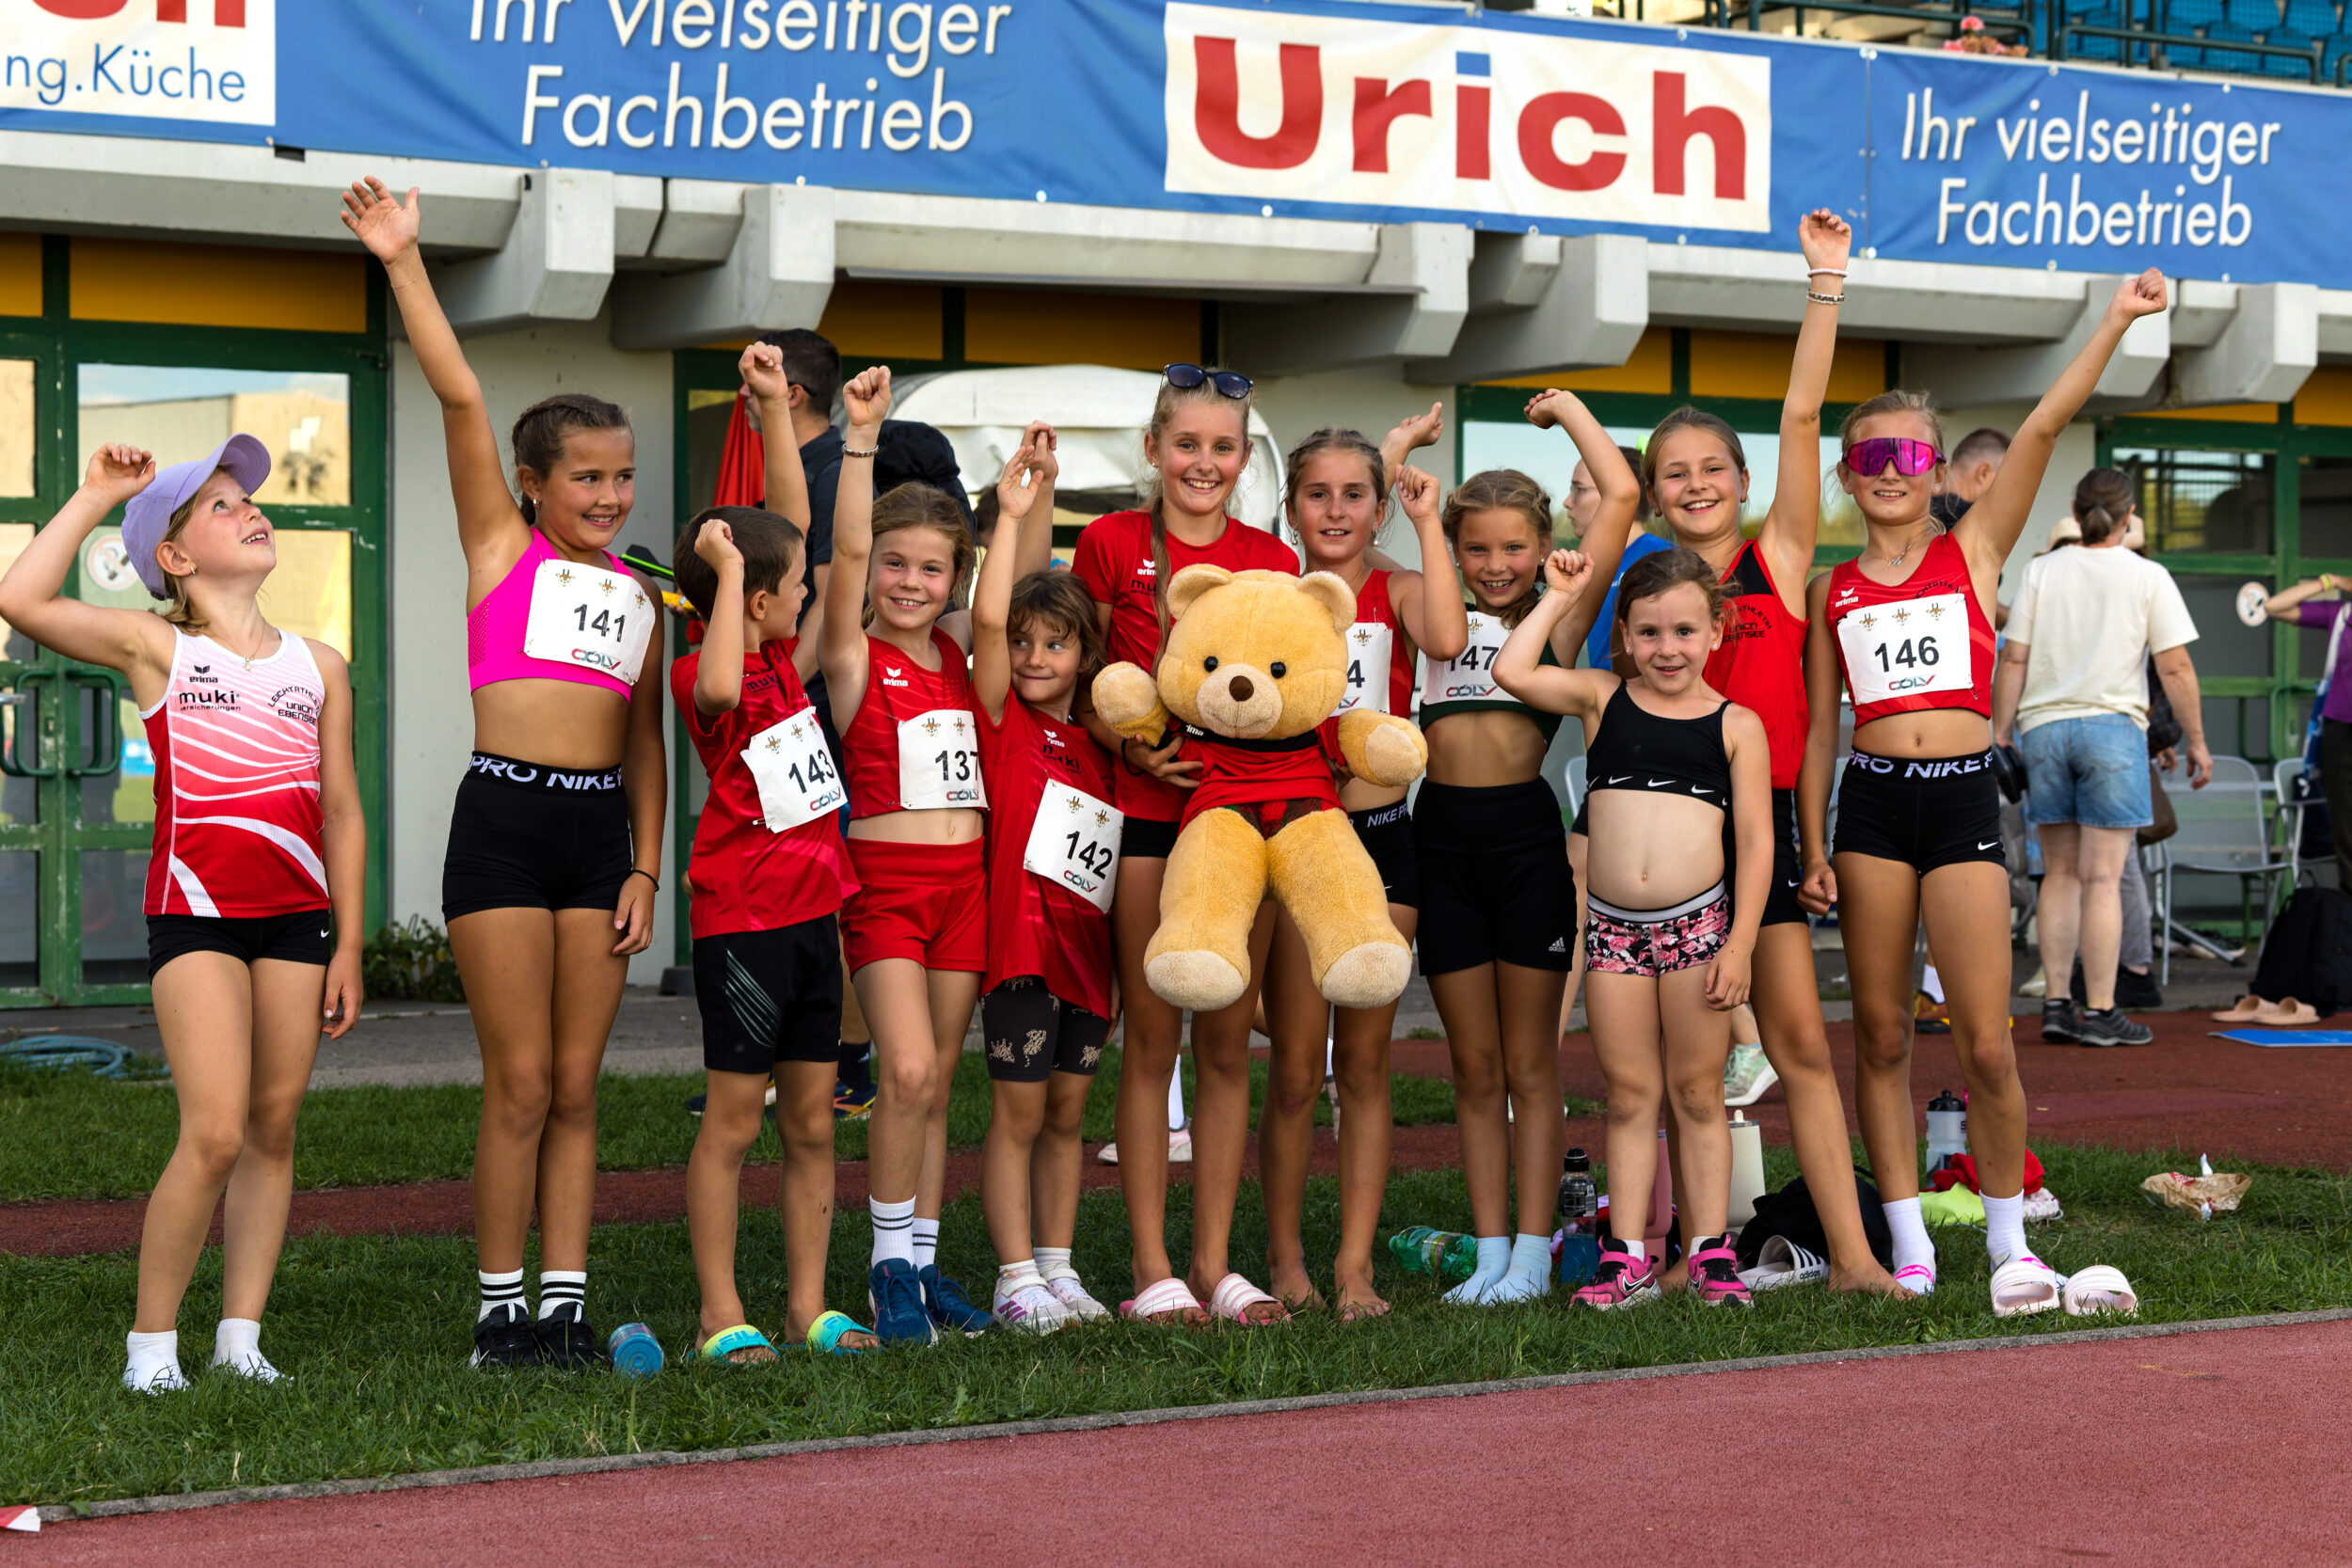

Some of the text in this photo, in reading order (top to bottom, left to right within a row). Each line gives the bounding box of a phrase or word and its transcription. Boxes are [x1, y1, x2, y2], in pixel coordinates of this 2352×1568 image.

[607, 0, 1011, 78] vielseitiger
[5, 43, 246, 105] ng.Küche
[521, 61, 974, 151] Fachbetrieb
[1193, 34, 1748, 201] Urich
[1901, 87, 2281, 185] Ihr vielseitiger
[1936, 172, 2253, 246] Fachbetrieb
[1136, 567, 1157, 576] erim
[1131, 579, 1157, 593] mu
[1835, 595, 1859, 608] erima
[573, 603, 627, 642] 141
[1874, 636, 1940, 673] 146
[189, 675, 219, 684] erima
[745, 673, 775, 691] muk
[883, 677, 909, 688] erima
[179, 689, 235, 705] muki
[278, 708, 317, 726] EBENSEE
[286, 701, 314, 716] UNION
[1185, 723, 1204, 736] rima
[468, 755, 538, 783] PRO
[546, 771, 616, 791] NIKE
[788, 749, 835, 794] 143
[1903, 759, 1982, 779] NIKE
[1366, 808, 1398, 828] NIKE
[1066, 830, 1114, 880] 142
[1799, 1269, 1821, 1280] adidas
